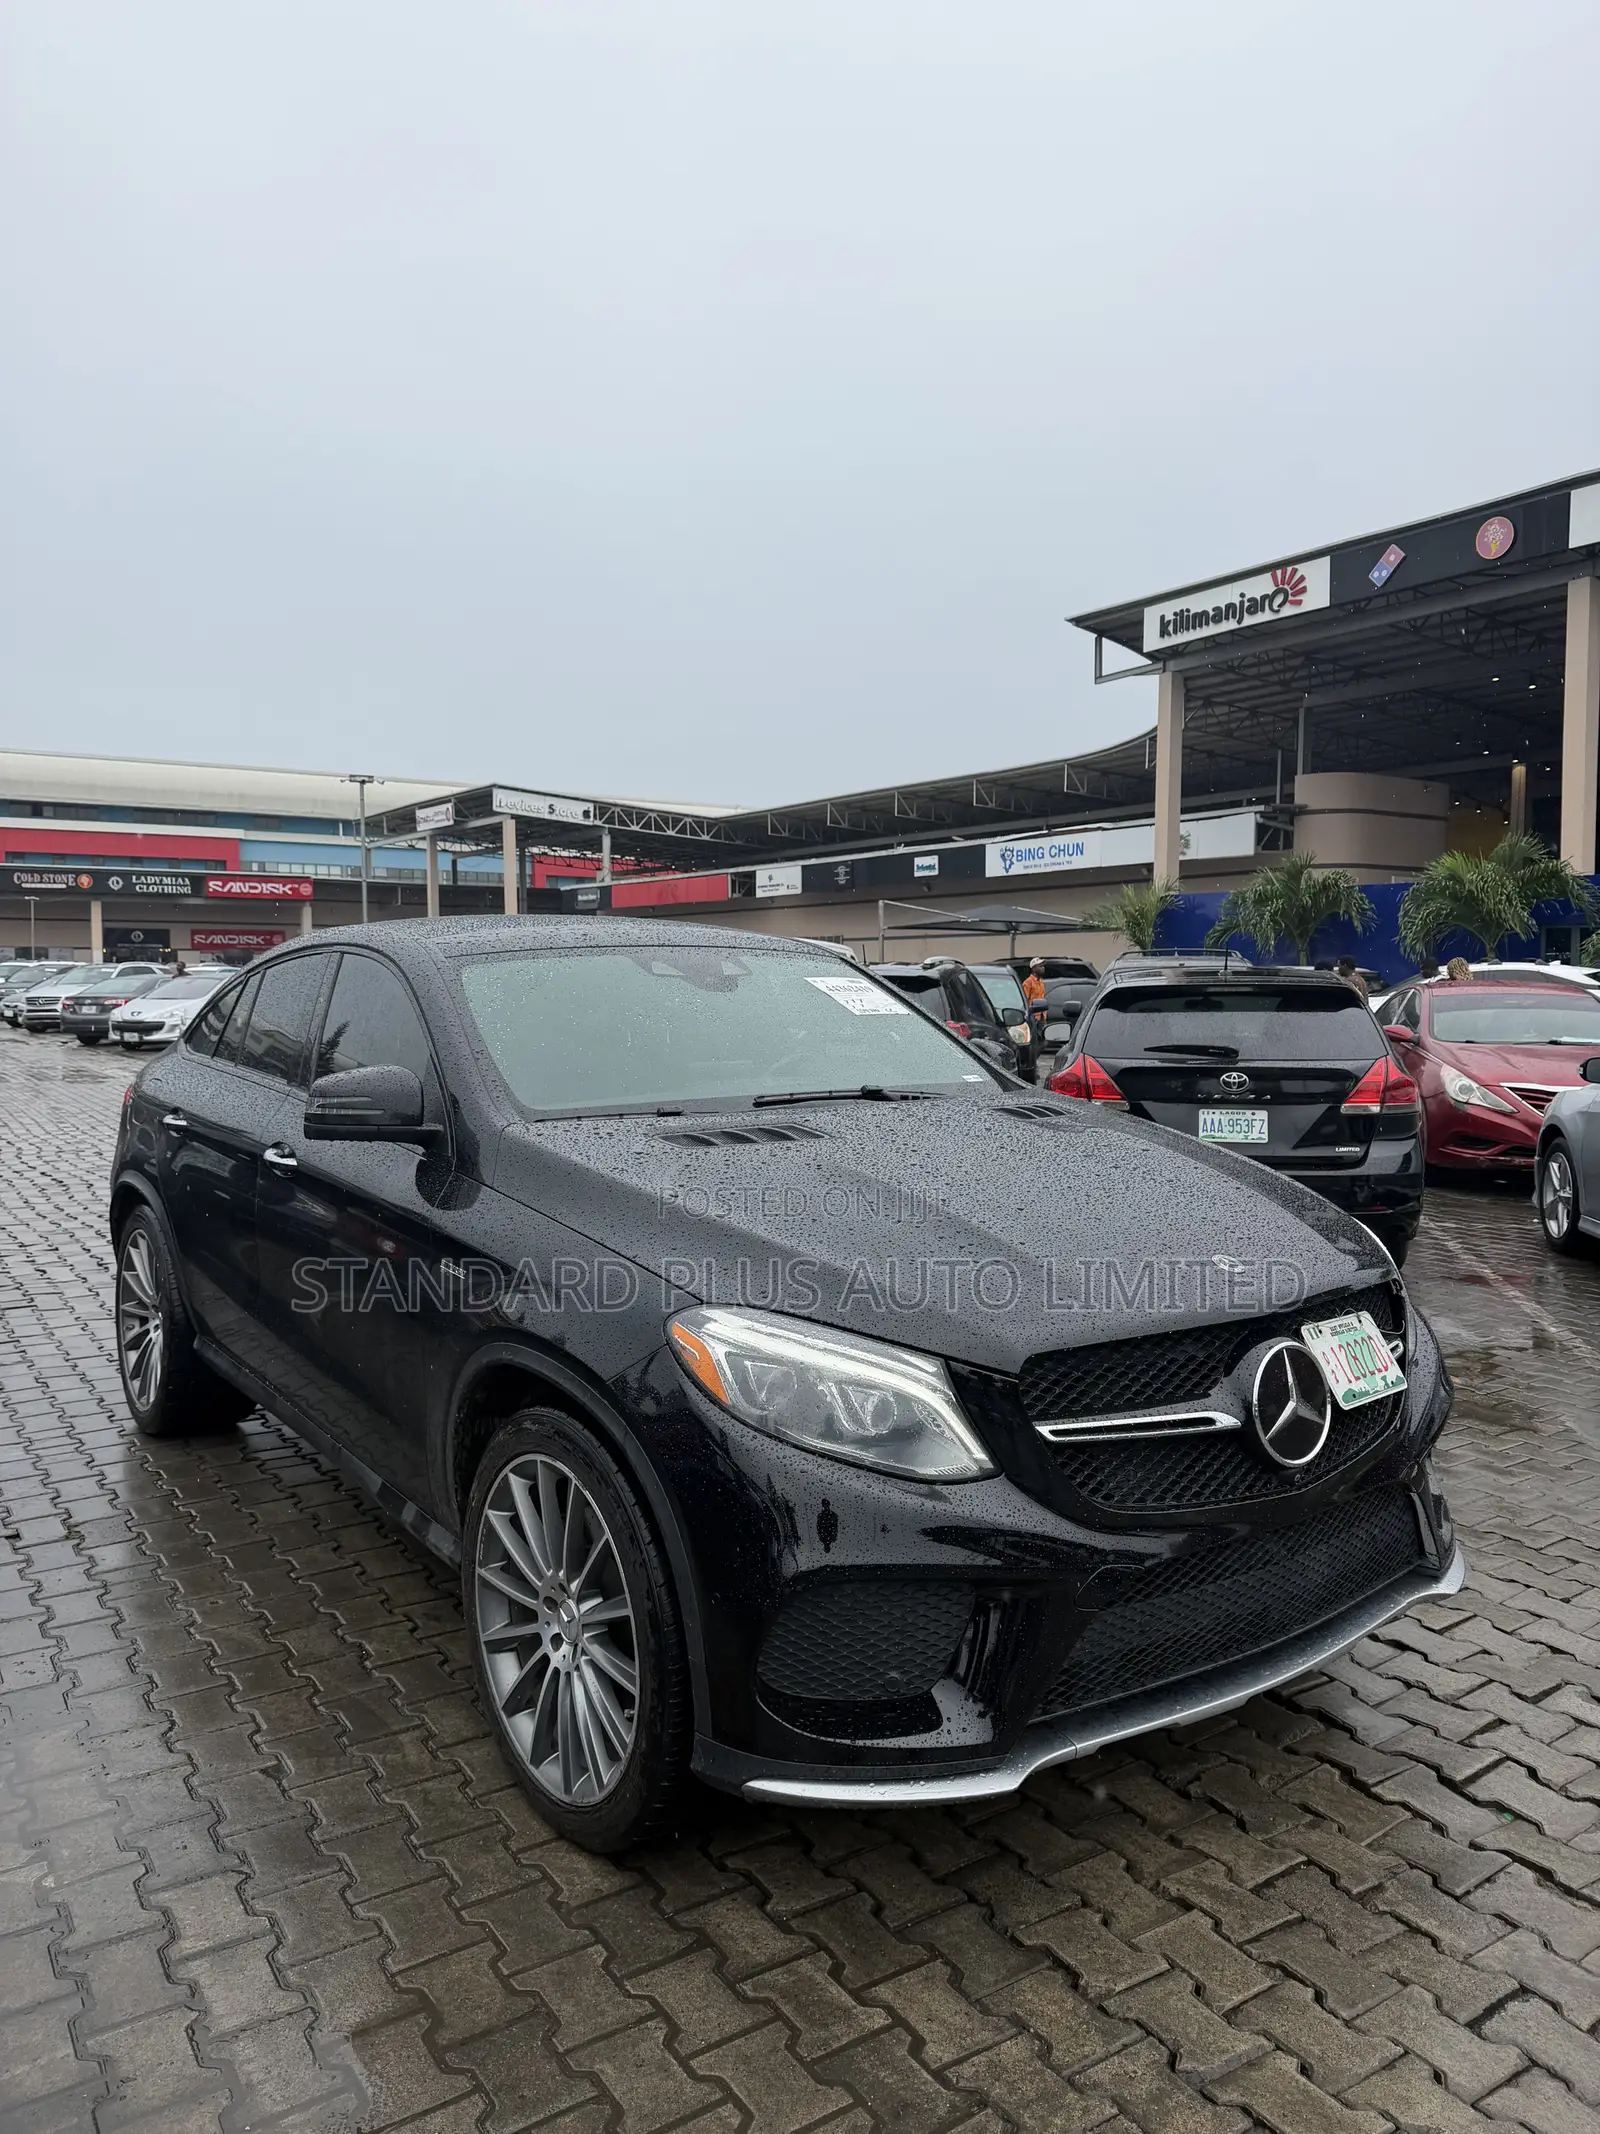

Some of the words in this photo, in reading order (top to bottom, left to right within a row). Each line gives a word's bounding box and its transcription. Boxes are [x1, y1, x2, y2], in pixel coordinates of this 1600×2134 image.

[1159, 586, 1290, 639] kilimanjaro
[548, 803, 579, 820] Store
[1016, 846, 1045, 862] BING
[1049, 842, 1084, 859] CHUN
[13, 872, 41, 884] COLD
[42, 873, 76, 886] STONE
[135, 884, 192, 894] CLOTHING
[208, 881, 293, 895] SANDISK
[193, 934, 265, 945] SANDISK
[1201, 1117, 1266, 1136] AAA-953FZ
